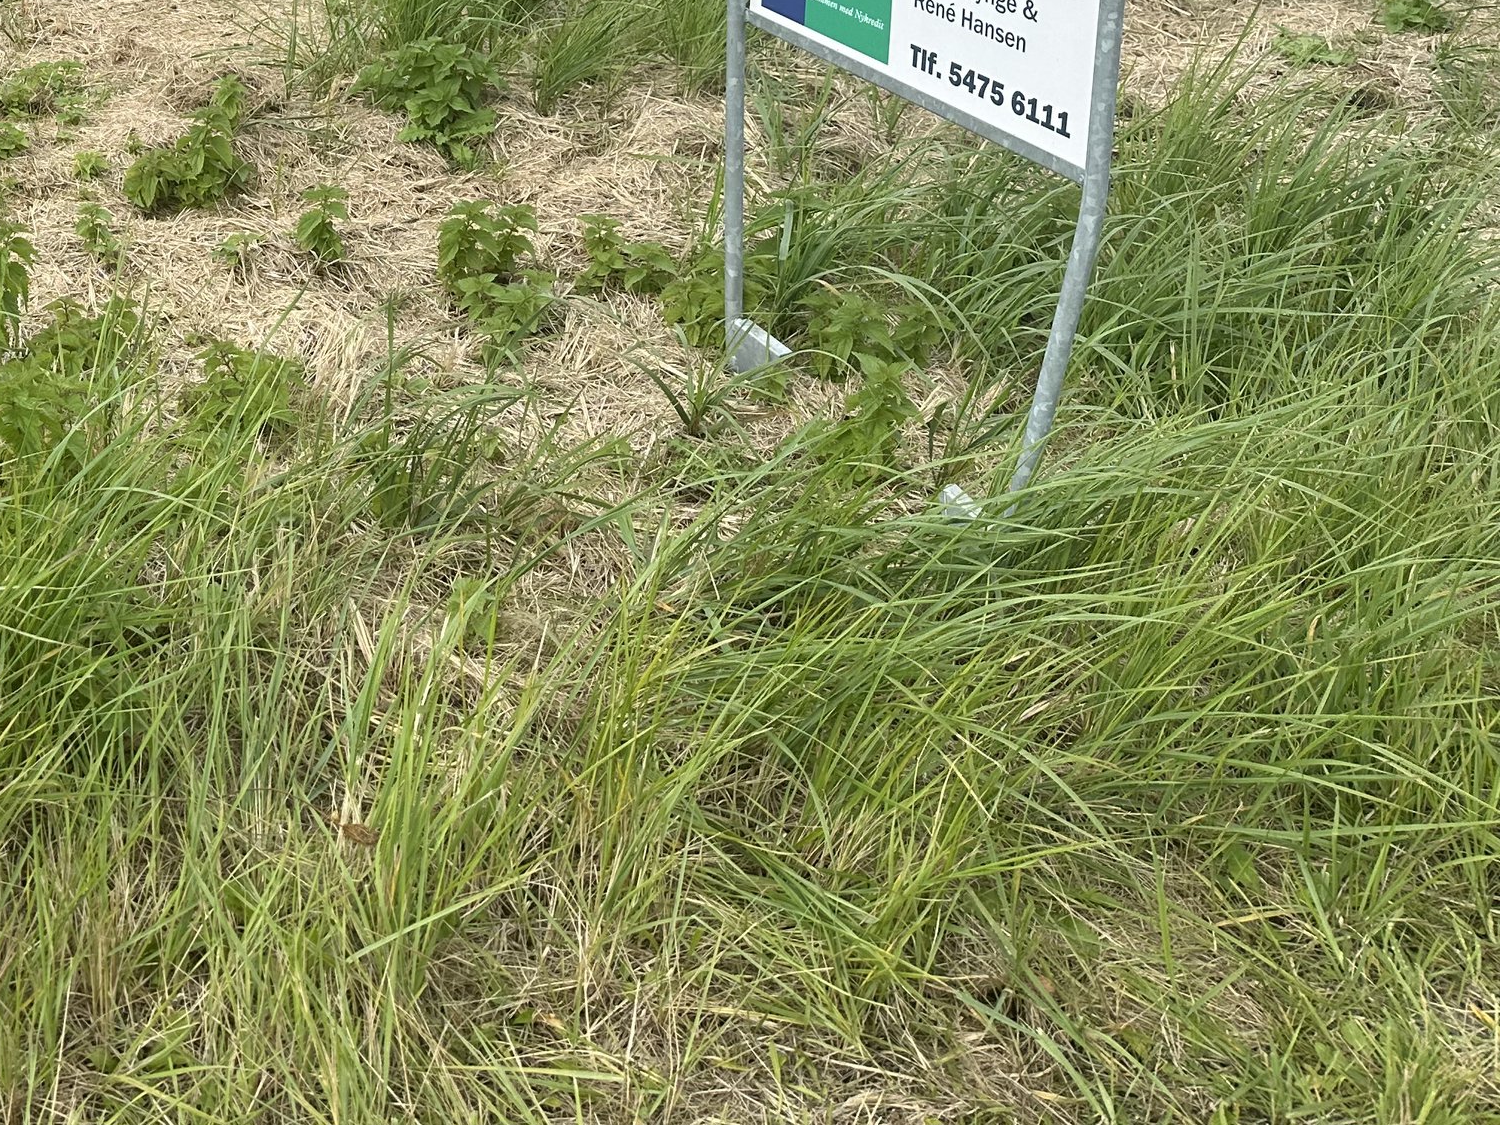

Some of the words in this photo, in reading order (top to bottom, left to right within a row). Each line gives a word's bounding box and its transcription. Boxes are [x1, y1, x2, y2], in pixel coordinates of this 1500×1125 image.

[838, 4, 854, 17] med
[854, 8, 885, 31] Nykredit
[1022, 0, 1039, 23] &
[961, 10, 1027, 53] Hansen
[910, 44, 942, 79] Tlf.
[949, 62, 1005, 106] 5475
[1011, 91, 1071, 138] 6111
